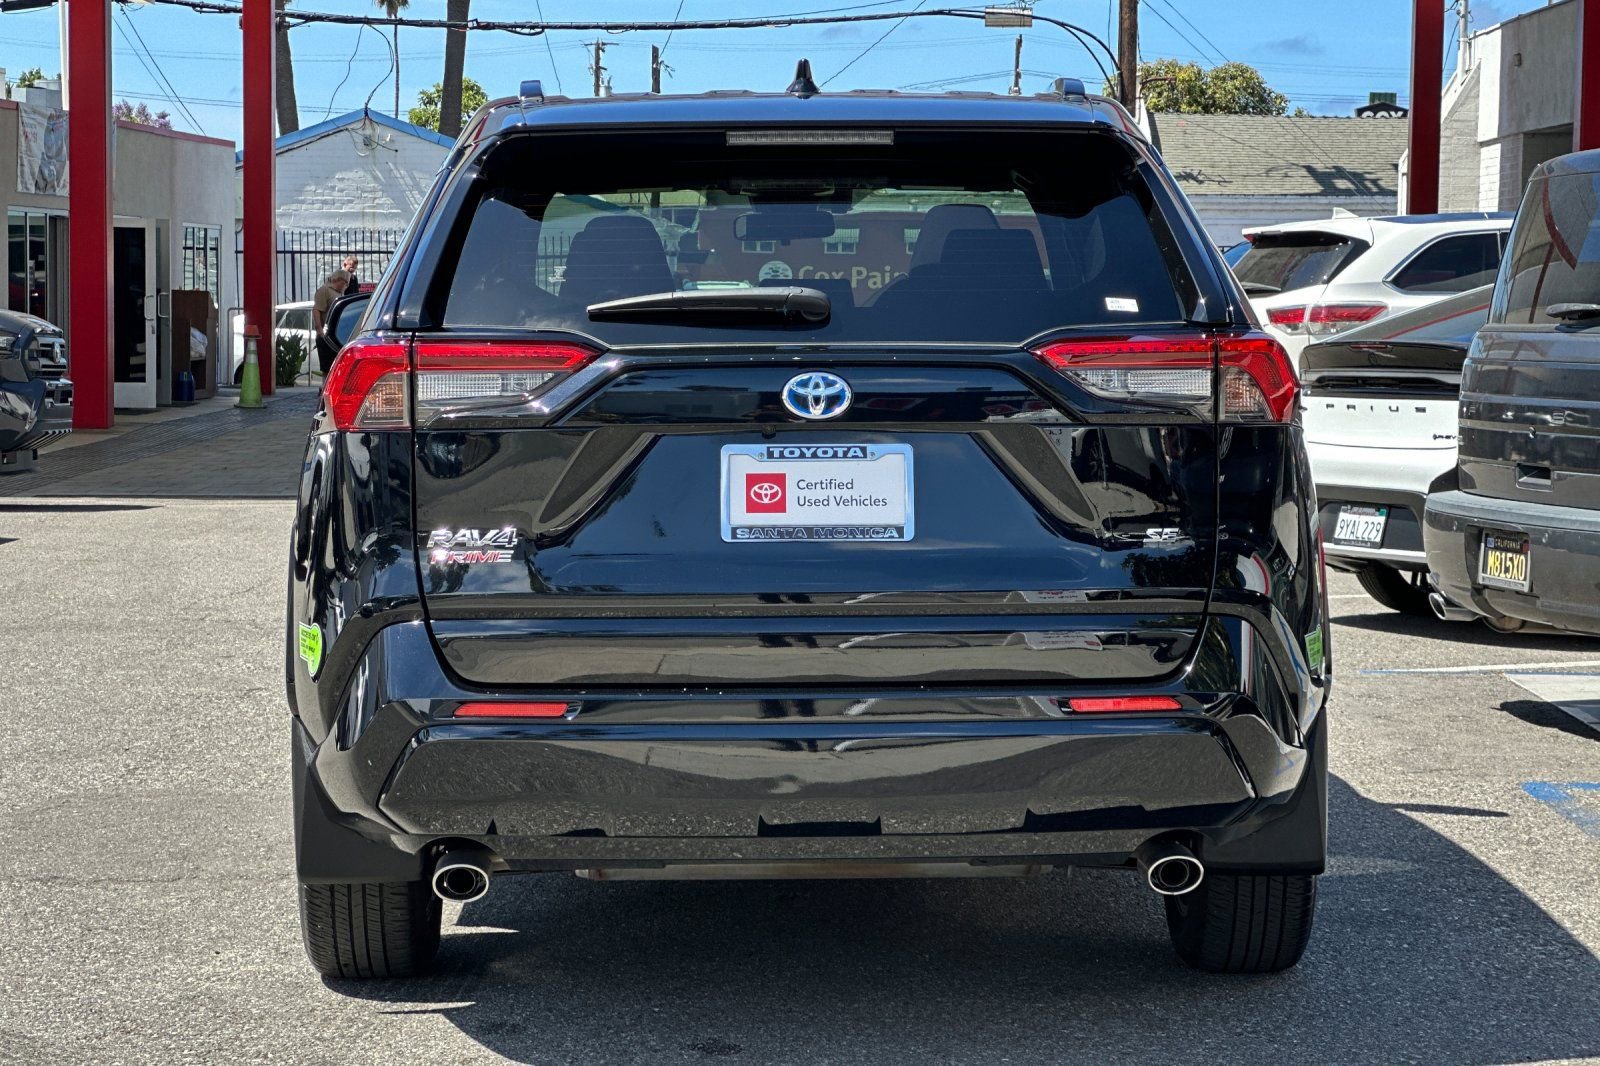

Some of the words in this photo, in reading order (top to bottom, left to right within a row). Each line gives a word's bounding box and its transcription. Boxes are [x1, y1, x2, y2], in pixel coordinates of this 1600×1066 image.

[1326, 403, 1427, 413] PRIUS
[769, 447, 865, 458] TOYOTA
[796, 478, 854, 491] Certified
[797, 495, 830, 507] Used
[834, 495, 888, 507] Vehicles
[736, 527, 808, 539] SANTA
[813, 527, 899, 539] MONICA
[1143, 527, 1180, 543] SE
[1337, 518, 1382, 541] 9YAL229
[426, 527, 518, 549] RAV4
[430, 550, 514, 565] PRIME
